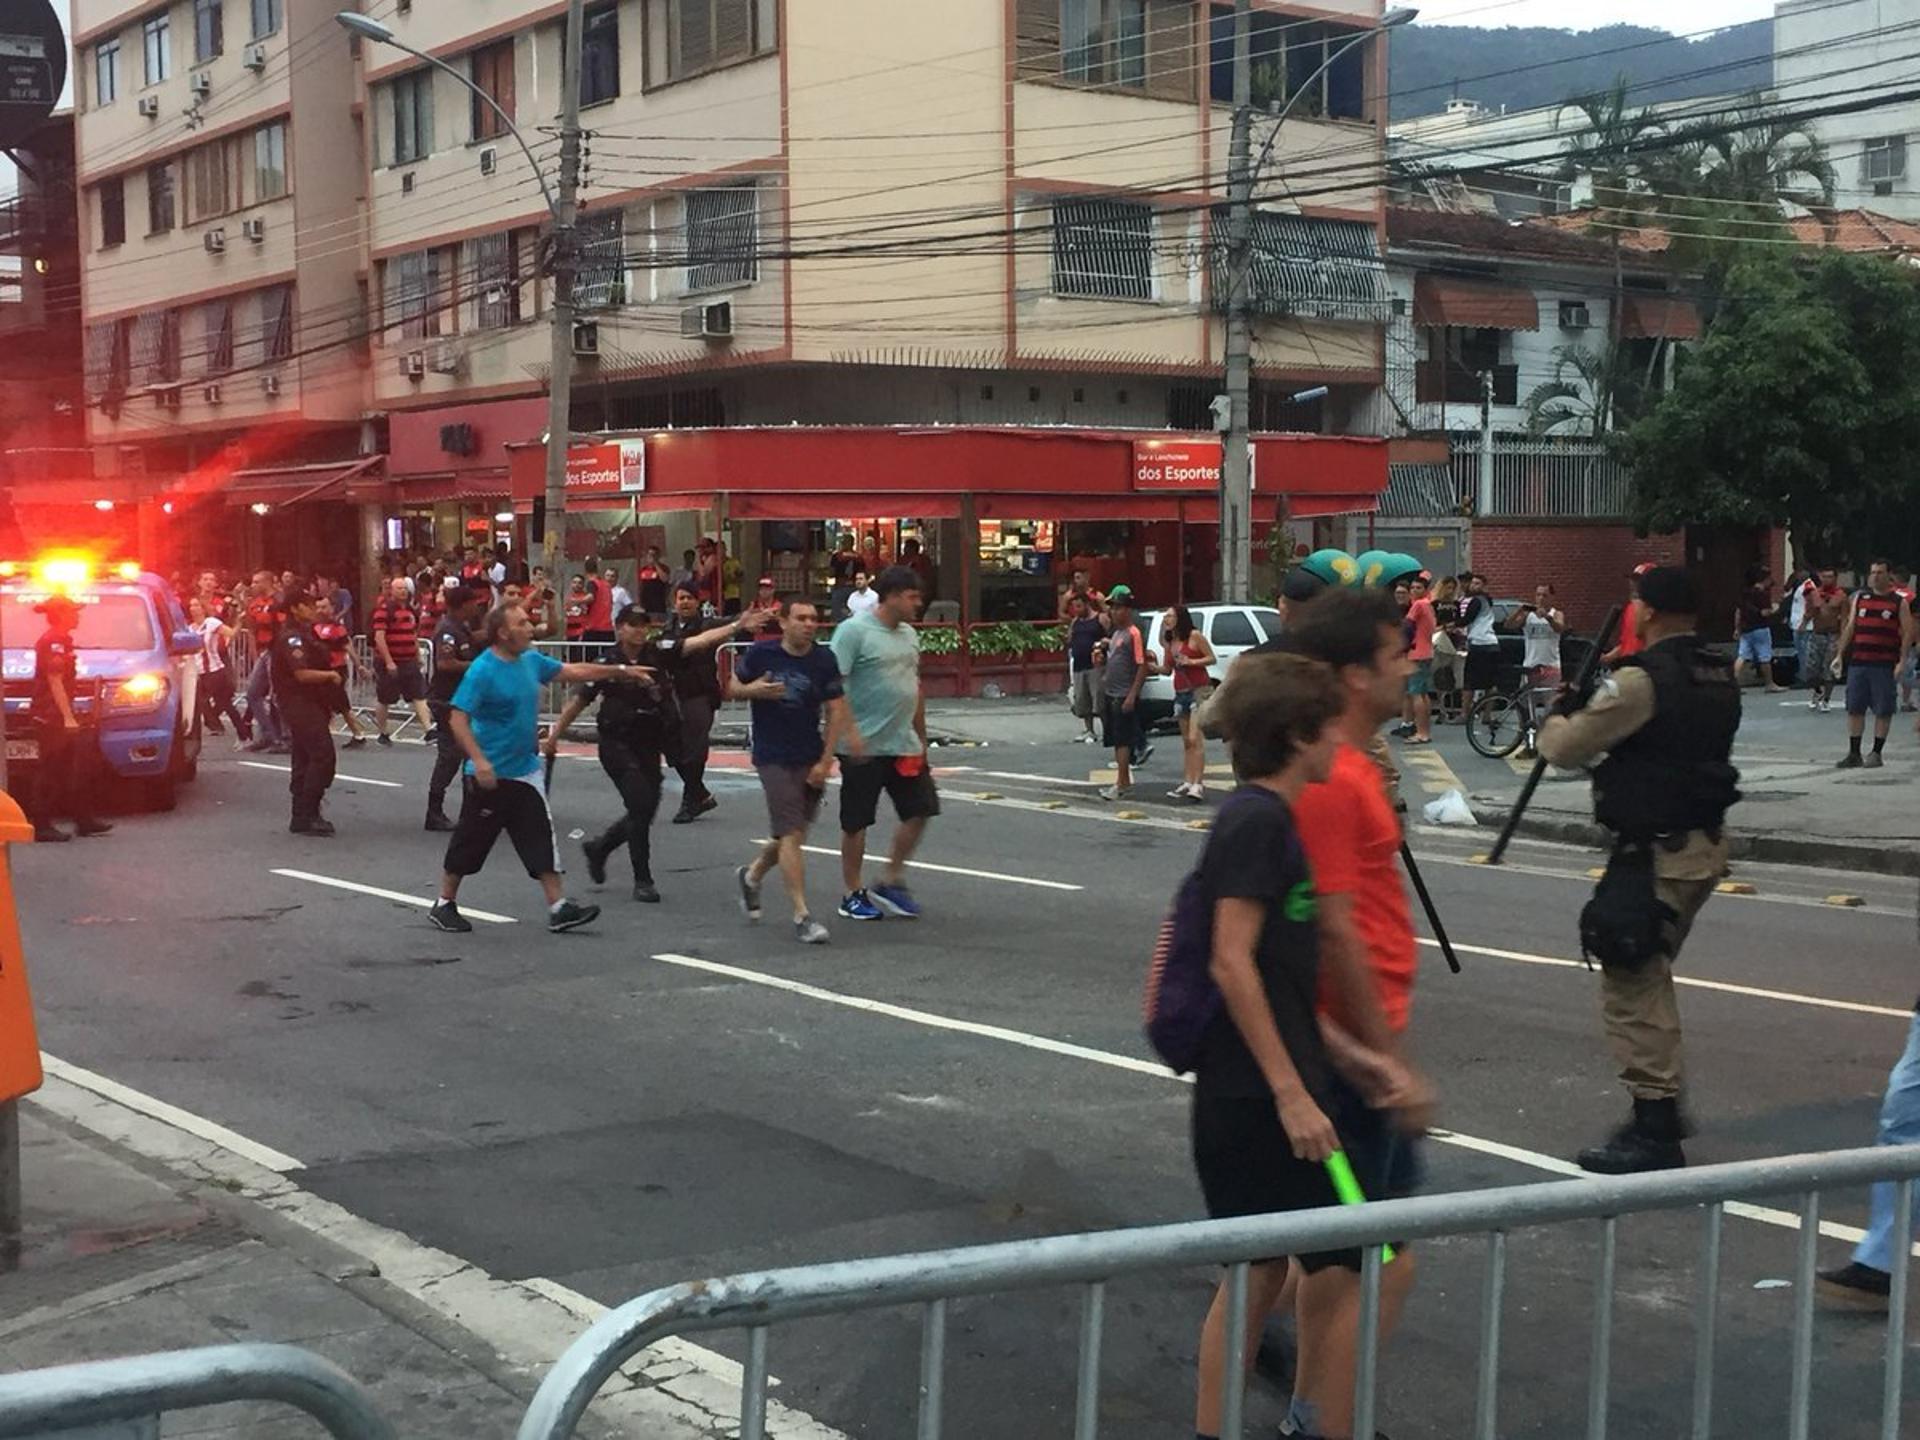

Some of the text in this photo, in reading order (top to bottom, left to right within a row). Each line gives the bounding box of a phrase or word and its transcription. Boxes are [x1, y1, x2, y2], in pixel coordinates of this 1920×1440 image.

[581, 469, 620, 486] Esportes
[1138, 465, 1220, 482] dos Esportes
